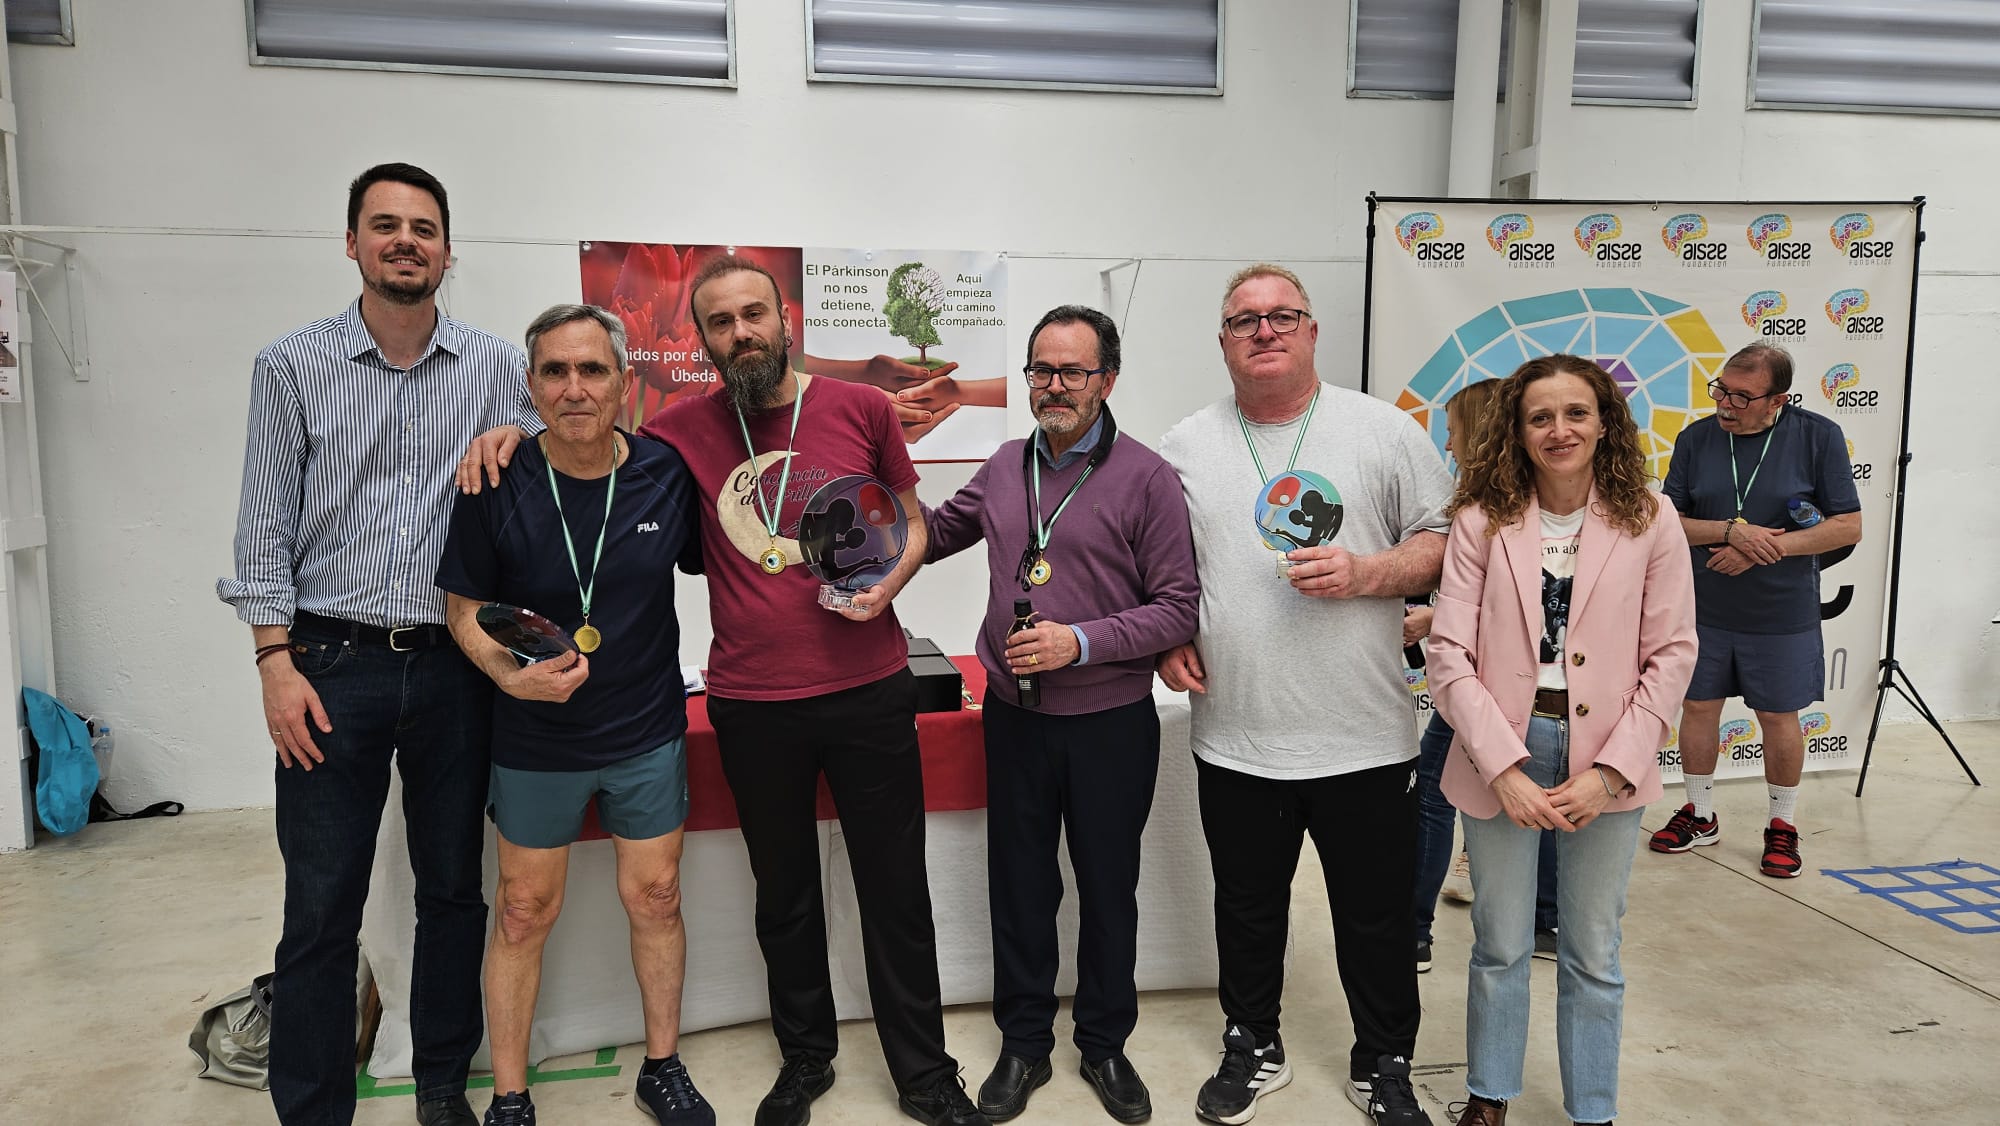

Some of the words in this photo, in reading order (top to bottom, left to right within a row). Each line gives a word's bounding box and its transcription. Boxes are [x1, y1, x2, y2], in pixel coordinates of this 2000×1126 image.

[806, 264, 818, 276] El
[823, 264, 889, 277] Párkinson
[824, 285, 841, 294] no
[844, 285, 868, 294] nos
[946, 288, 992, 299] empieza
[821, 299, 875, 312] detiene,
[943, 303, 953, 312] tu
[956, 302, 996, 312] camino
[805, 318, 829, 327] nos
[833, 317, 890, 328] conecta.
[932, 316, 1006, 328] acompañado.
[663, 351, 687, 364] por
[671, 366, 717, 382] Úbeda
[637, 521, 660, 533] FILA
